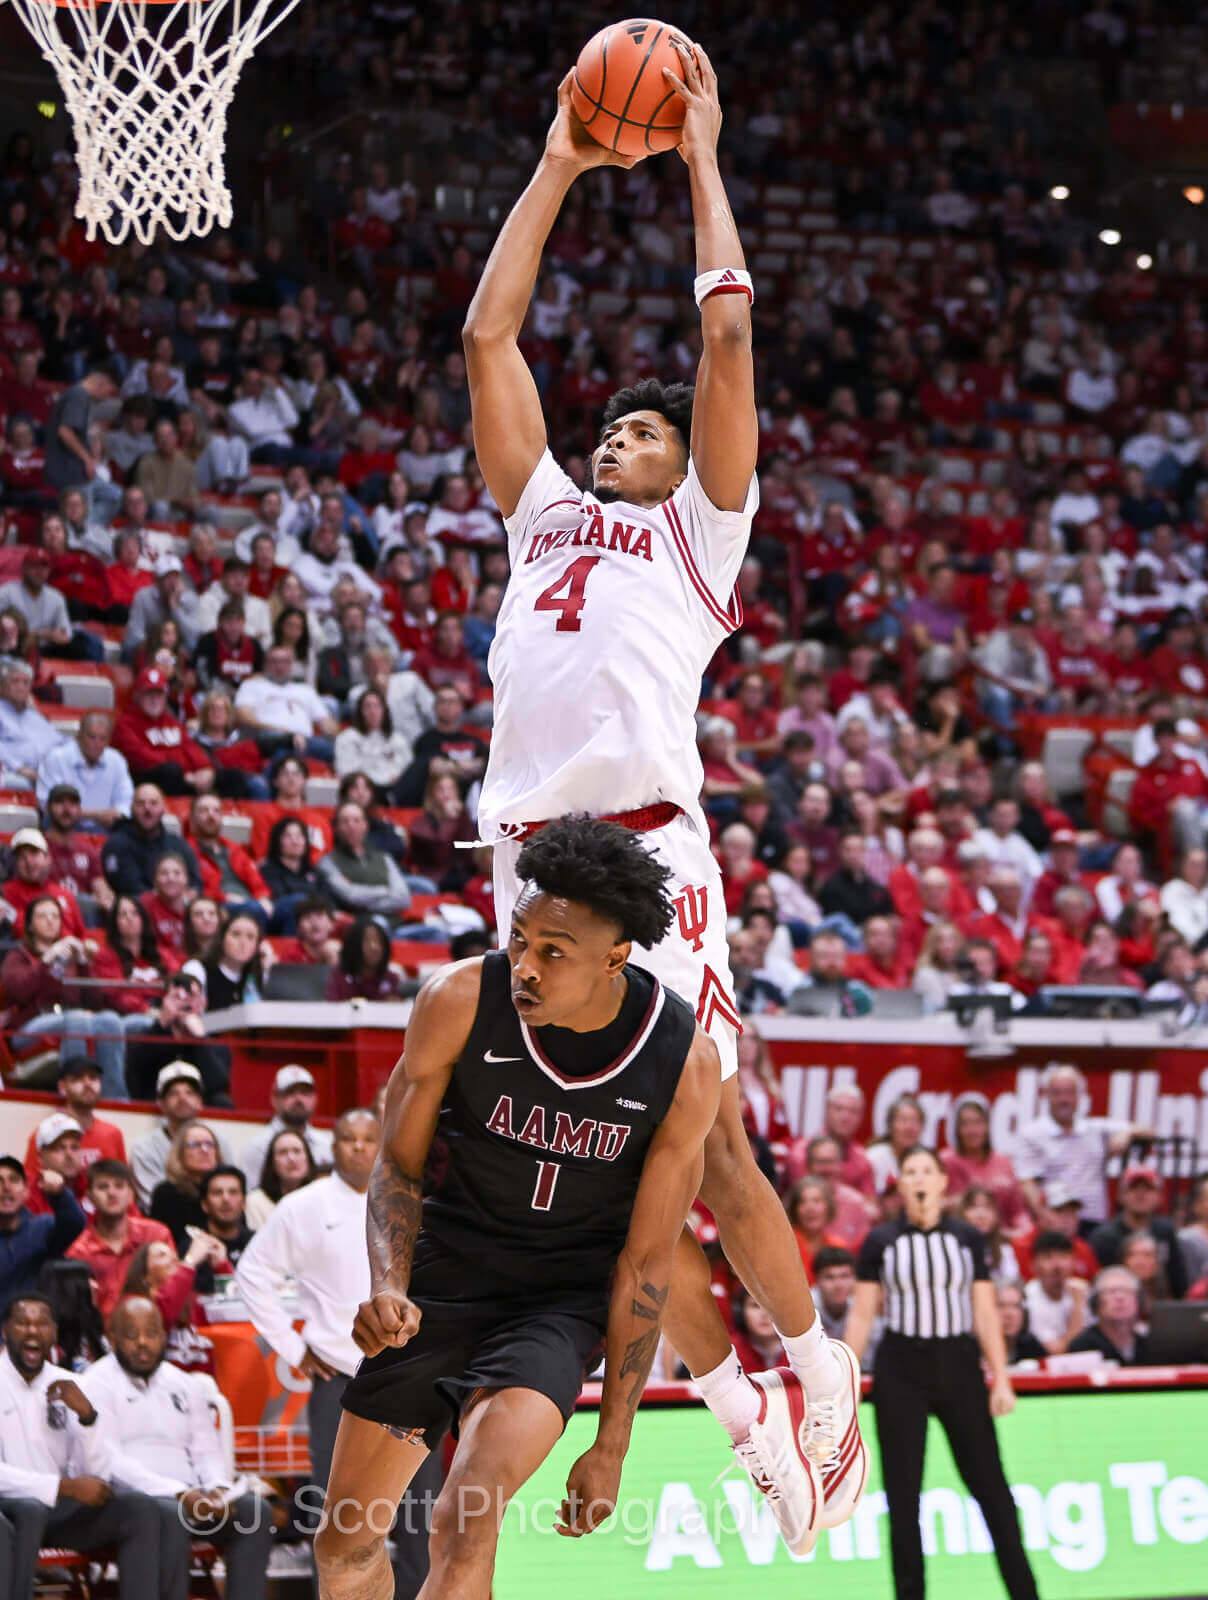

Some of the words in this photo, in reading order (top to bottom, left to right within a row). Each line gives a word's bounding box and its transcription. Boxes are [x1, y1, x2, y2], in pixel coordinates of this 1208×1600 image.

[524, 515, 653, 564] INDIANA
[534, 555, 601, 632] 4
[485, 1094, 631, 1161] AAMU
[531, 1160, 561, 1212] 1
[644, 1481, 724, 1572] A
[1108, 1461, 1208, 1546] Te
